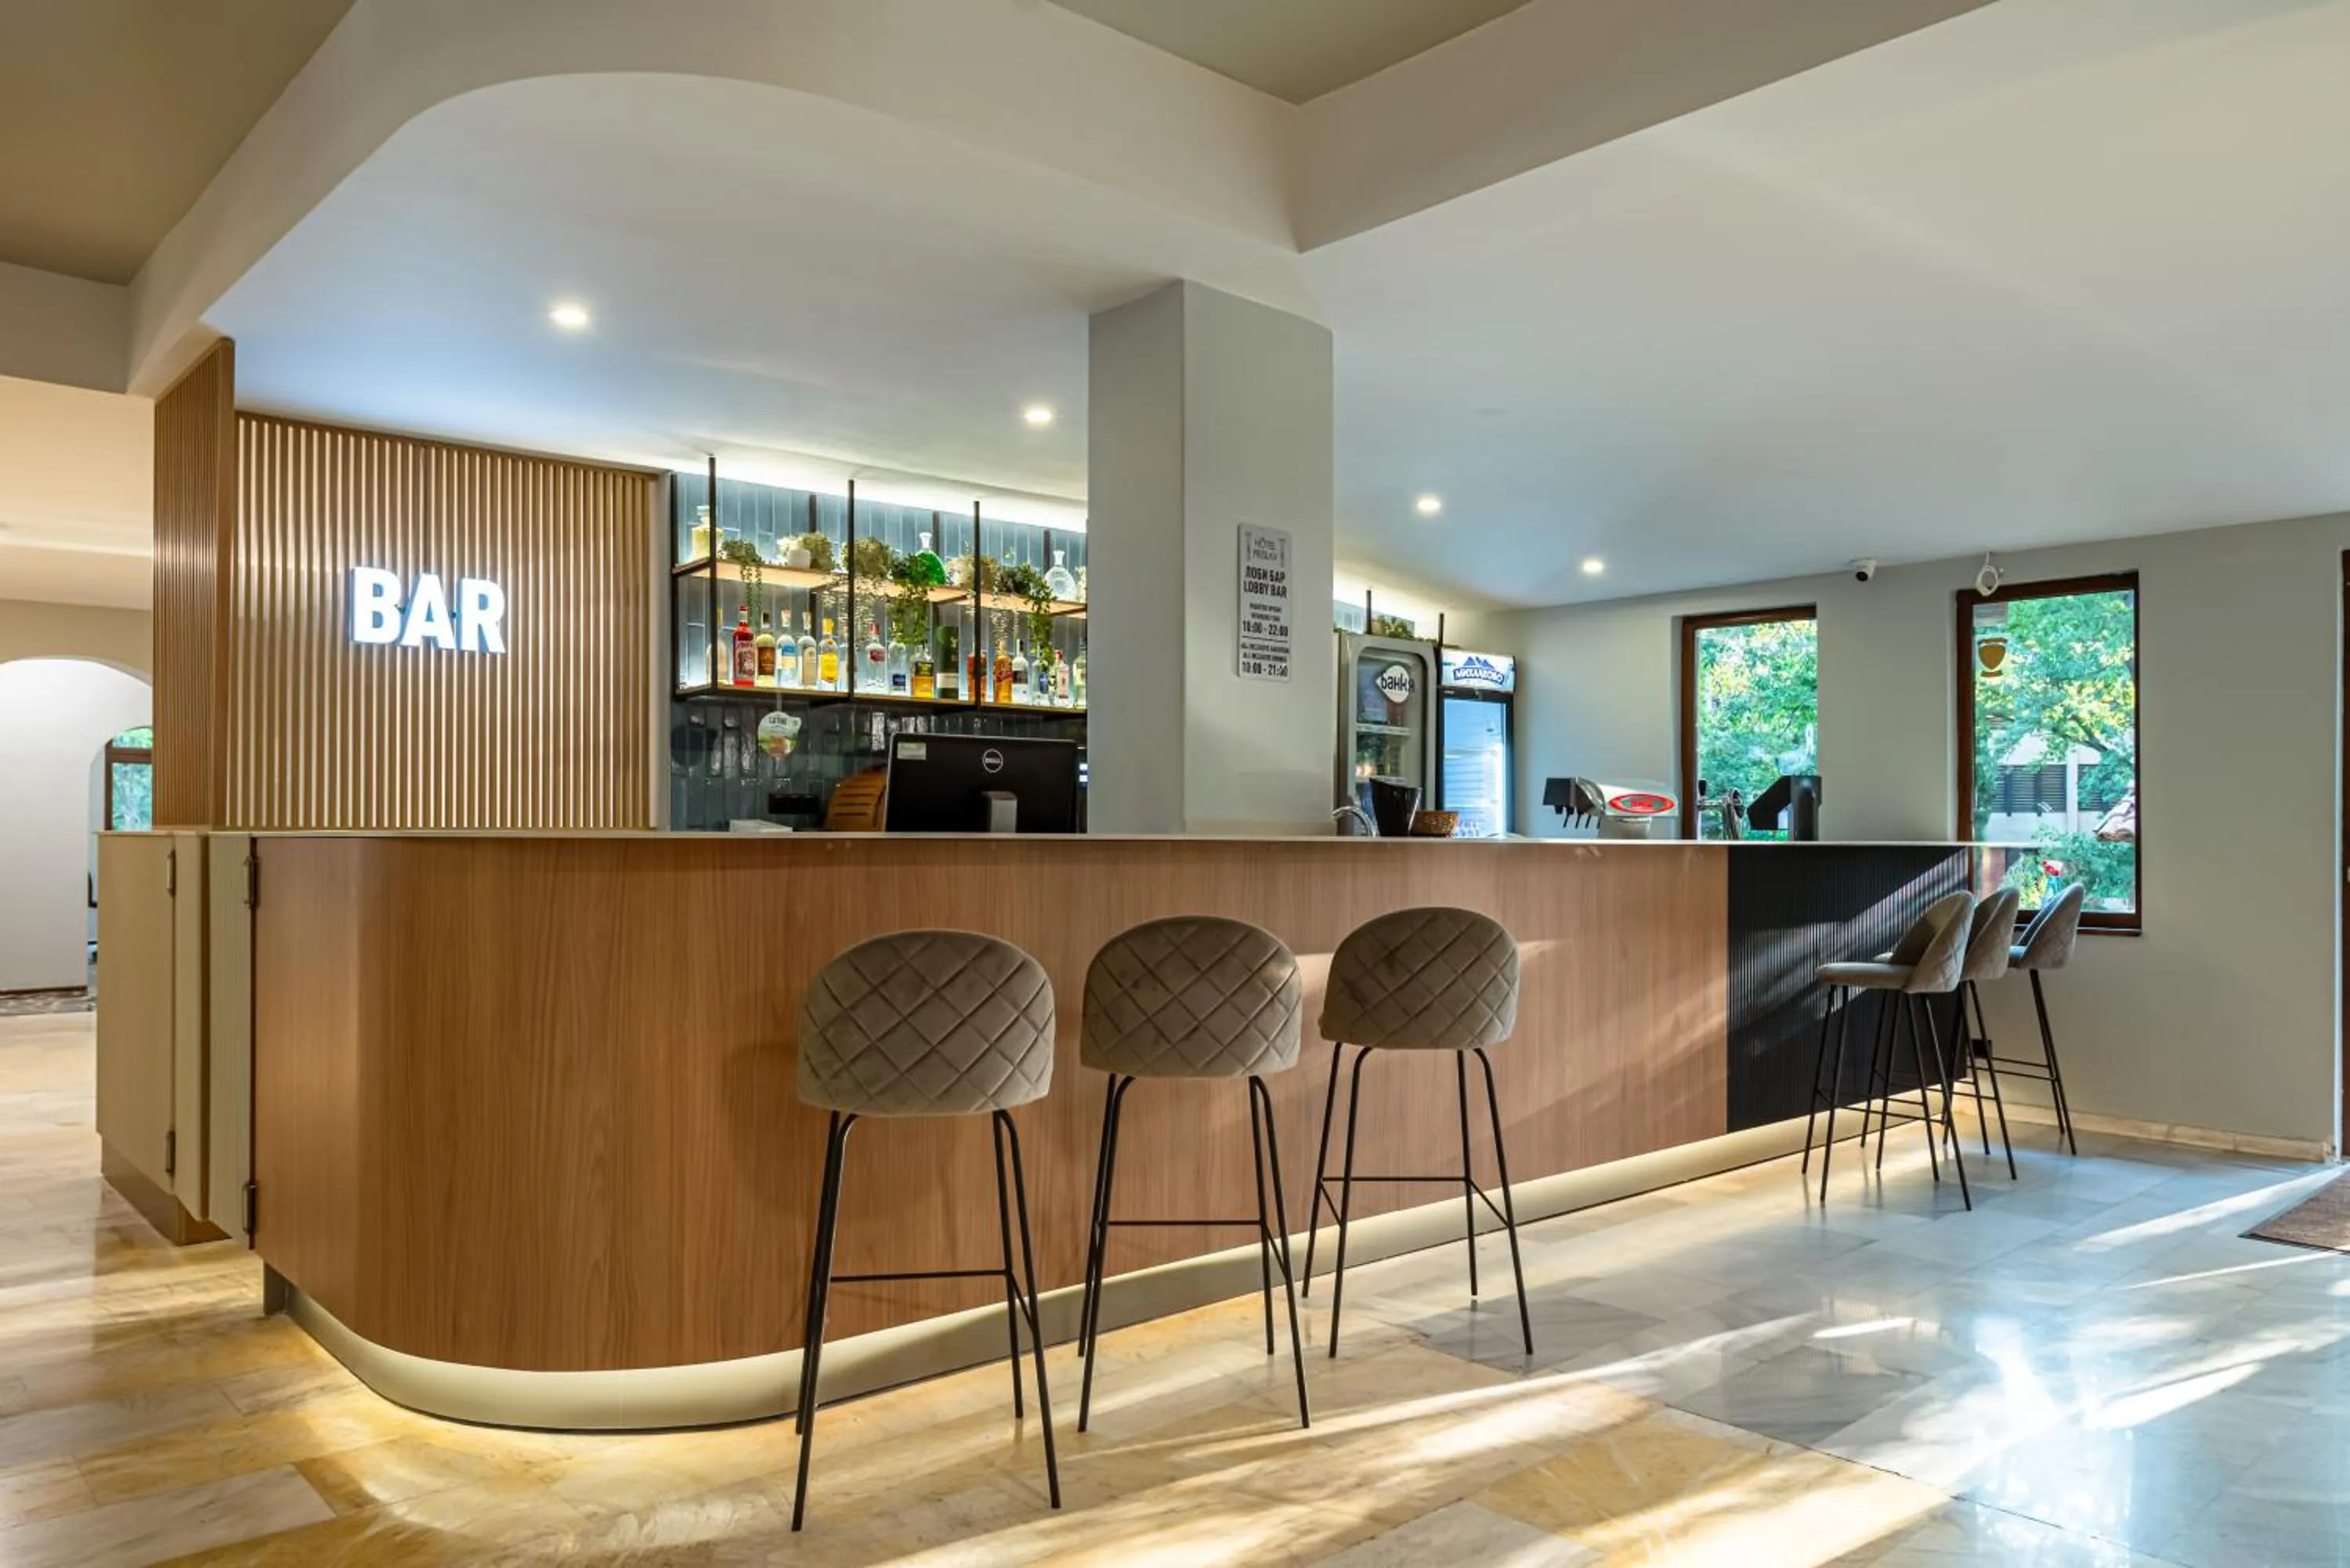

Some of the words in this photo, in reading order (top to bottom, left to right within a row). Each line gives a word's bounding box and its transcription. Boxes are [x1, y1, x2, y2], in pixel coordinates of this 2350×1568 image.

[1246, 565, 1267, 580] ЛОБИ
[1270, 569, 1285, 583] БАР
[1243, 580, 1269, 595] LOBBY
[1271, 583, 1288, 598] BAR
[352, 566, 506, 654] BAR
